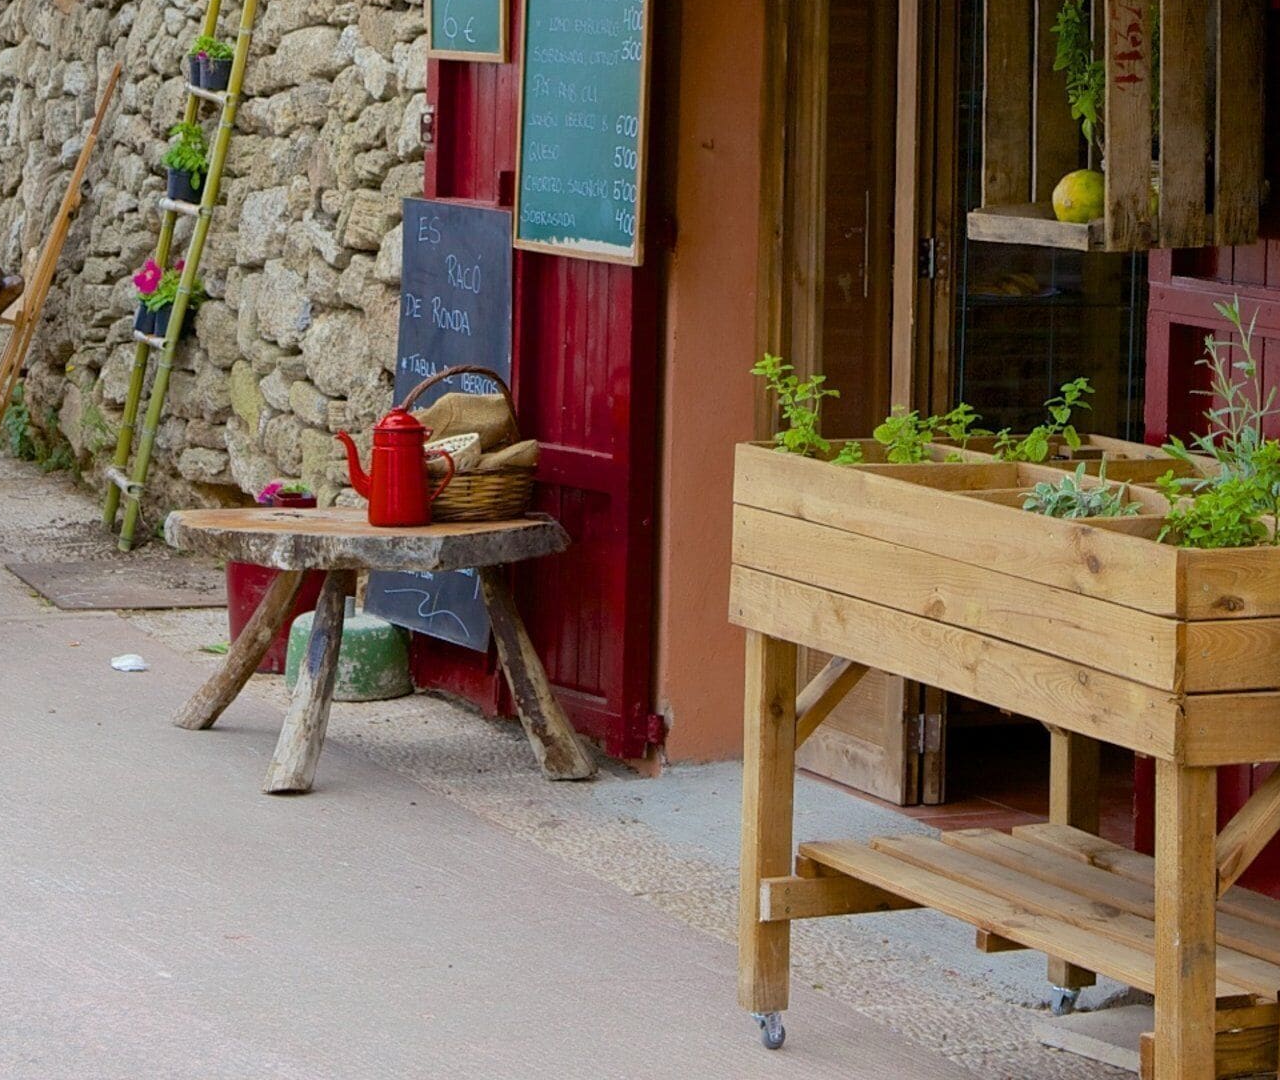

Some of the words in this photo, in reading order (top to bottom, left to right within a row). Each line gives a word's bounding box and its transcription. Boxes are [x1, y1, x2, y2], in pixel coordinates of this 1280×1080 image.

[463, 17, 477, 44] €
[418, 217, 442, 245] ES
[404, 293, 421, 318] DE
[431, 296, 472, 337] RONDA
